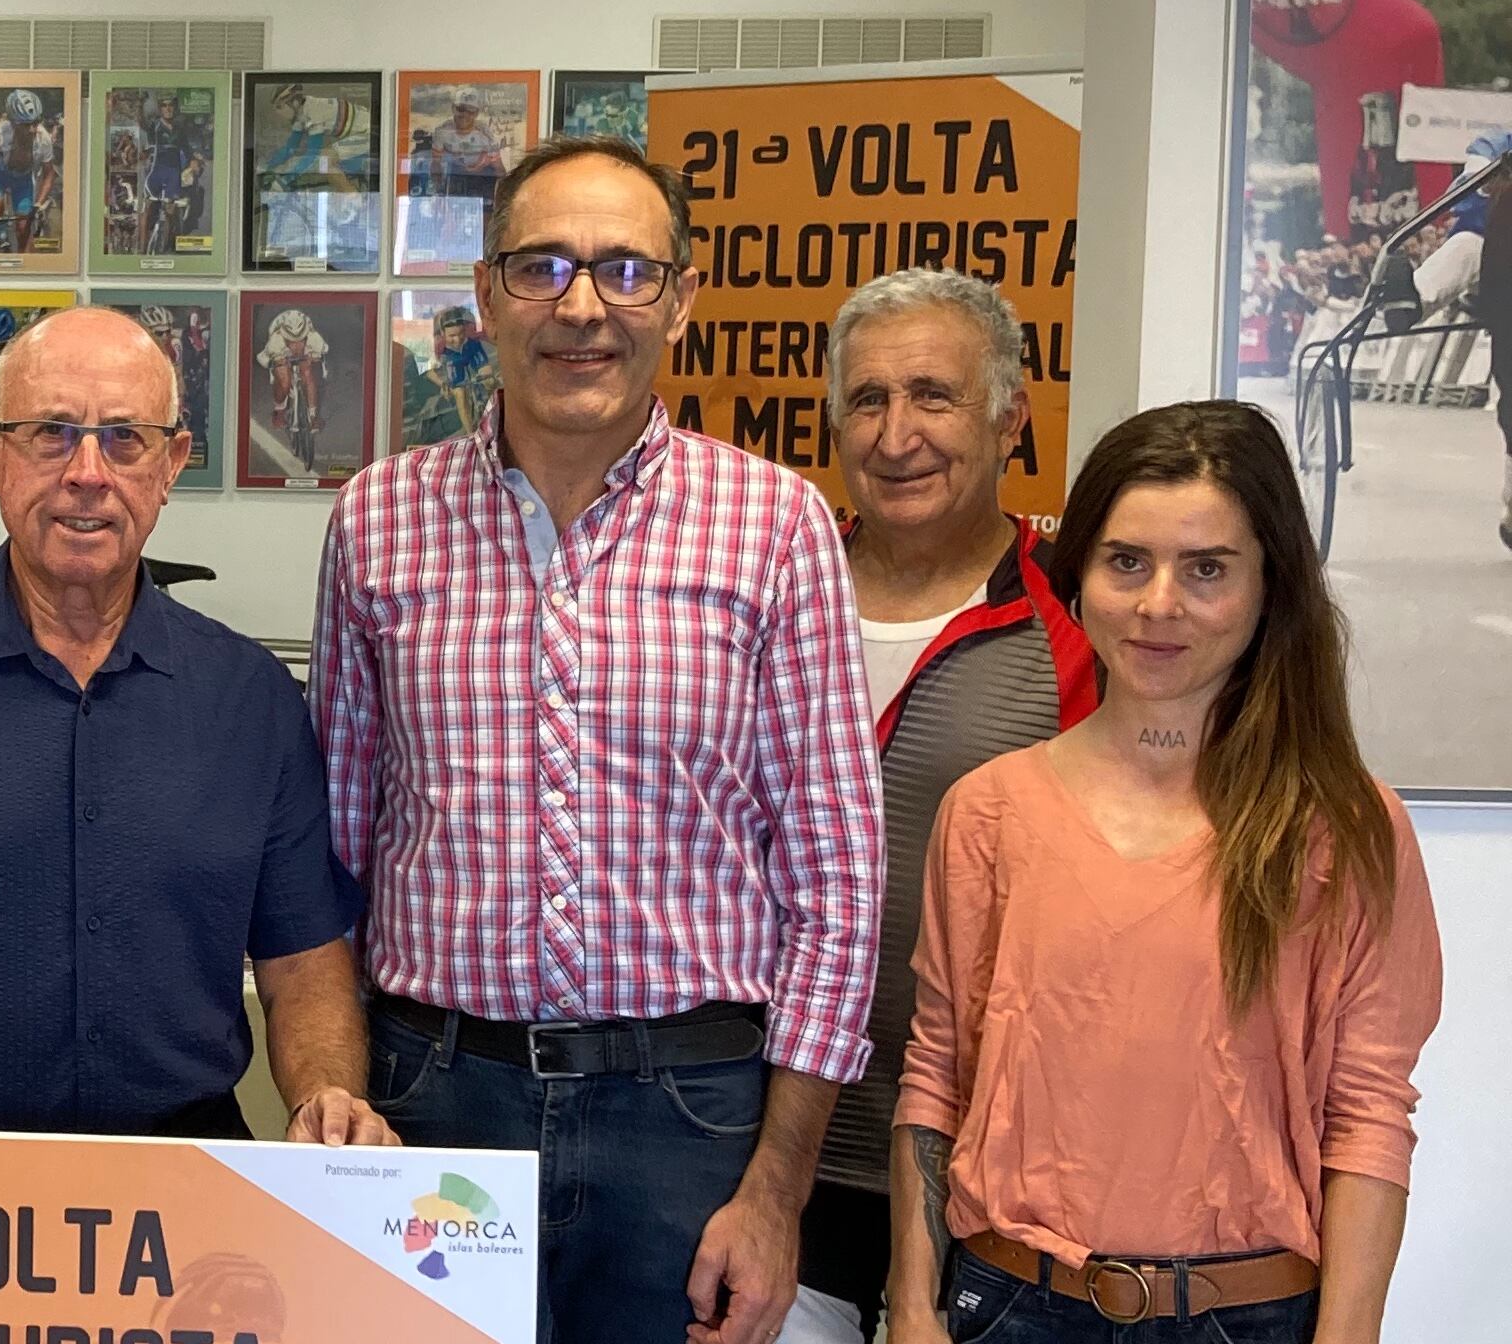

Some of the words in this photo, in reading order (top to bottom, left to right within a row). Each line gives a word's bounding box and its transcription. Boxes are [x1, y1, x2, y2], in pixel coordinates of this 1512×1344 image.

[808, 119, 1019, 198] VOLTA
[1138, 728, 1186, 748] AMA
[325, 1164, 380, 1177] Patrocinado
[382, 1166, 402, 1179] por:
[384, 1217, 518, 1240] MENORCA
[448, 1241, 473, 1253] islas
[477, 1242, 524, 1255] baleares
